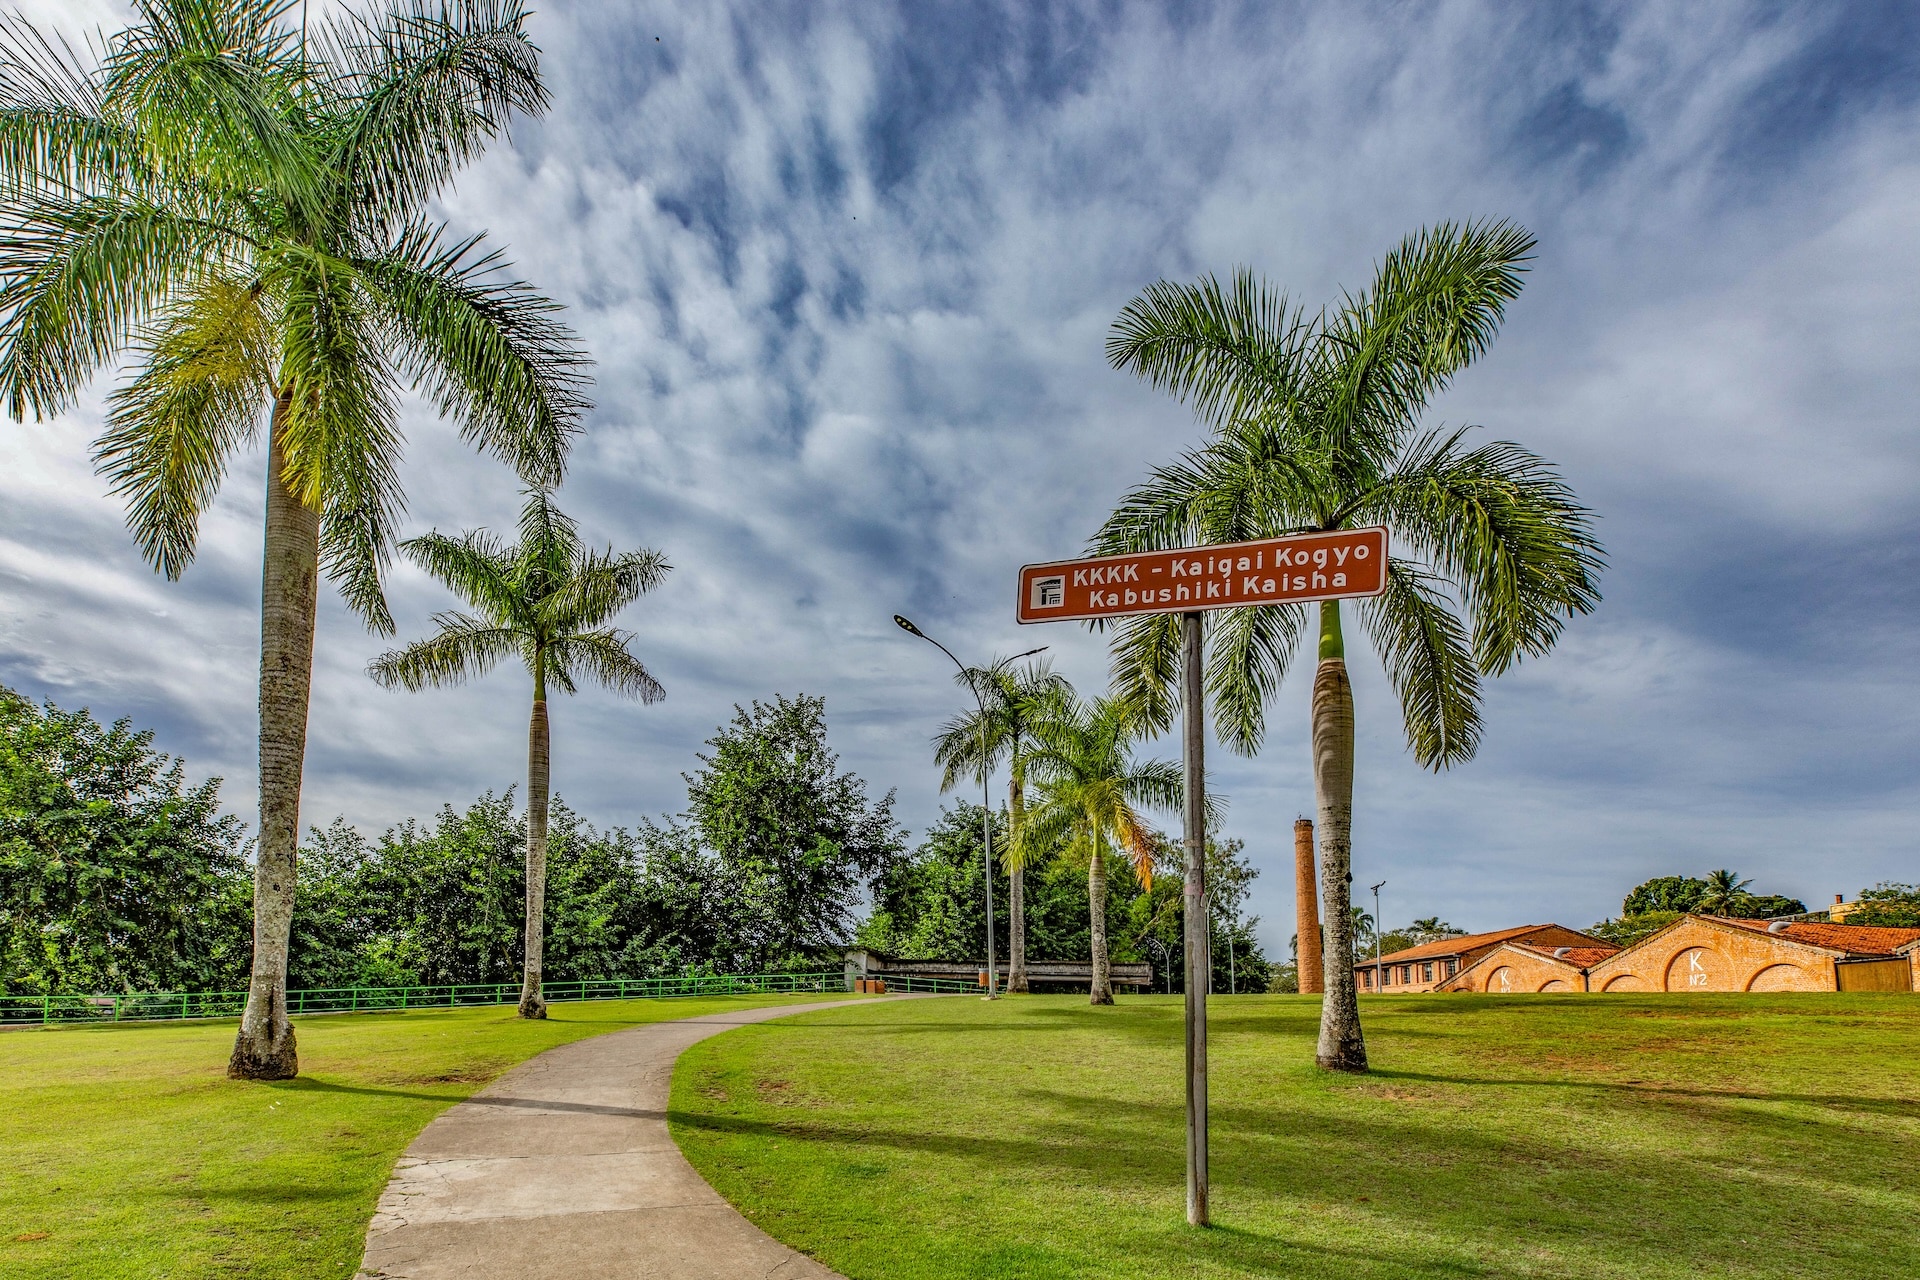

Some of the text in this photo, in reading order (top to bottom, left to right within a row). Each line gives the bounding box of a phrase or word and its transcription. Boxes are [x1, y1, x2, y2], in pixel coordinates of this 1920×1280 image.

[1073, 563, 1139, 587] KKKK
[1171, 550, 1263, 580] Kaigai
[1275, 543, 1370, 570] Kogyo
[1089, 570, 1348, 608] Kabushiki Kaisha
[1690, 952, 1704, 972] K
[1501, 969, 1510, 985] K
